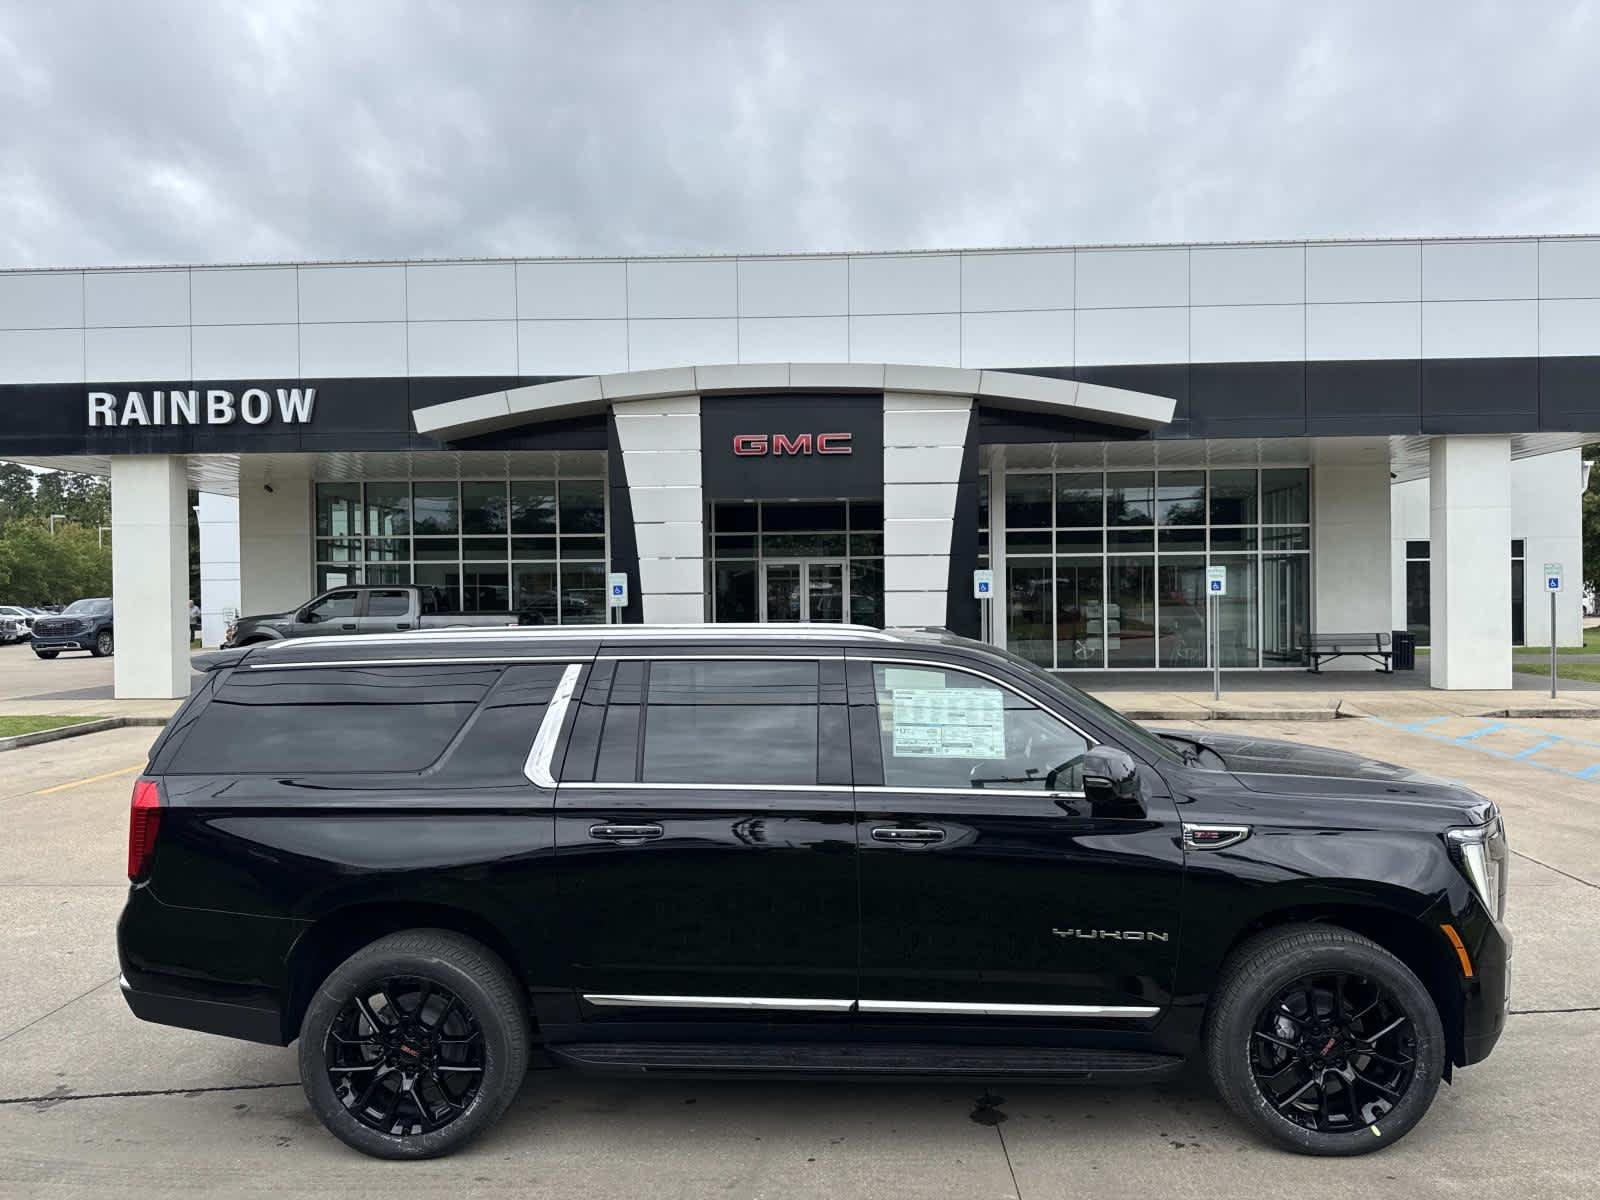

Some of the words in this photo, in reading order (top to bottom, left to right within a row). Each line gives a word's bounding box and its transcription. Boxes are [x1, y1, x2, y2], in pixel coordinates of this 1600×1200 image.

[88, 388, 316, 426] RAINBOW
[733, 433, 852, 456] GMC
[1052, 928, 1169, 942] YUKON
